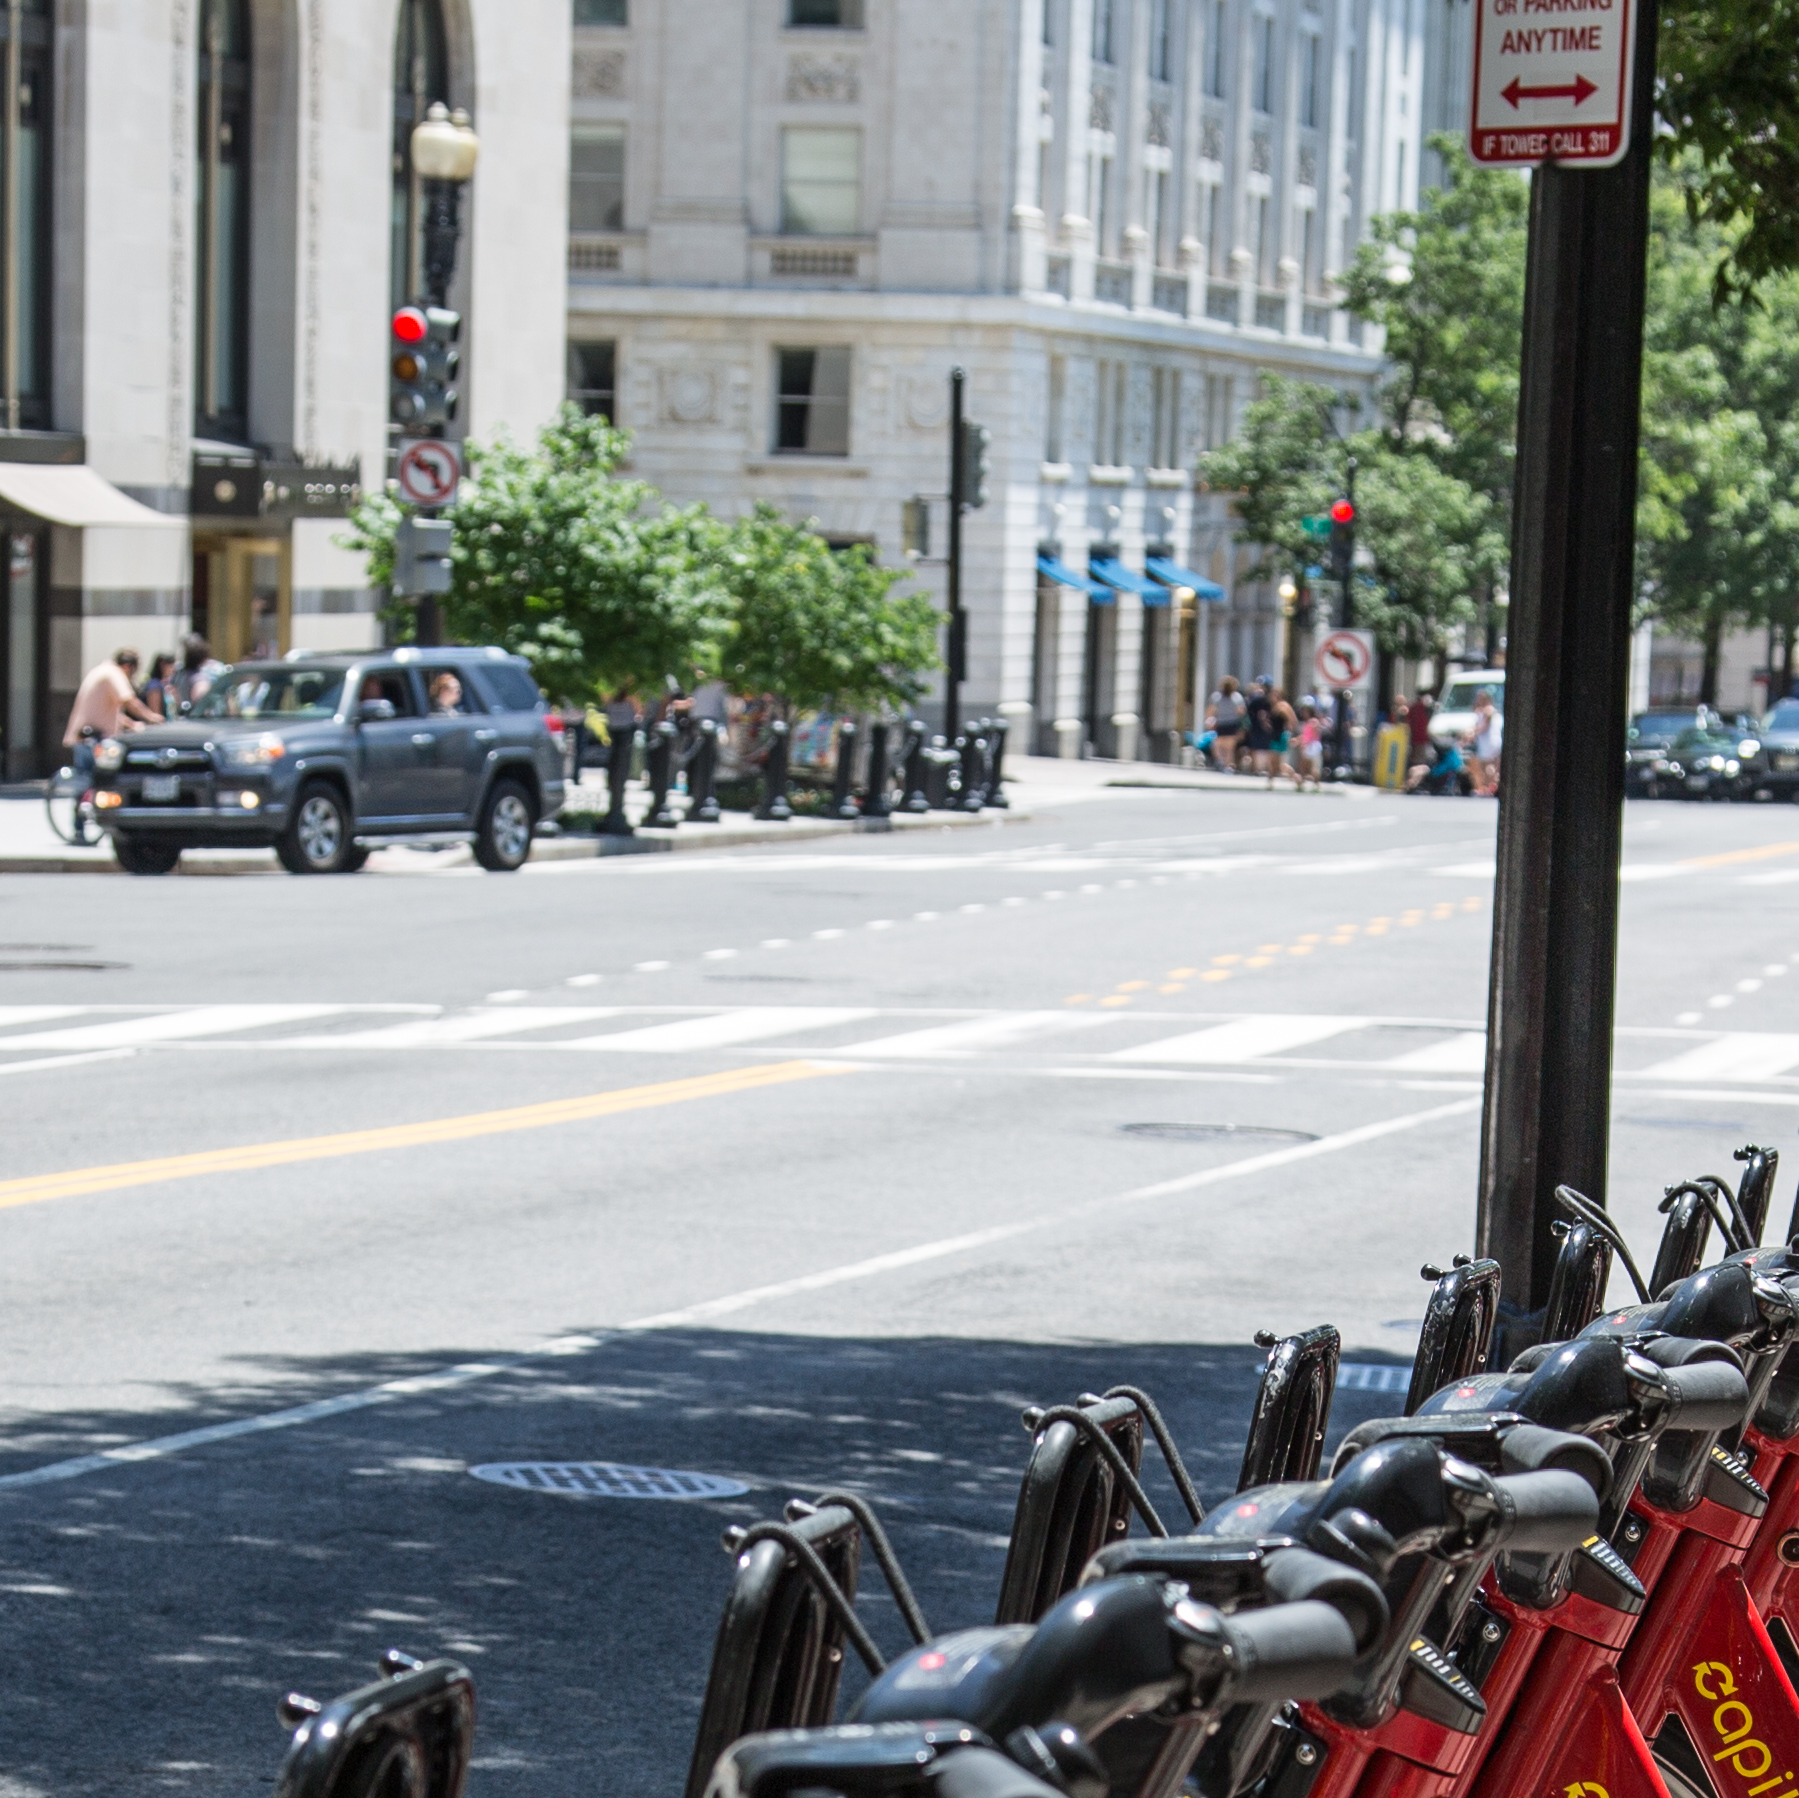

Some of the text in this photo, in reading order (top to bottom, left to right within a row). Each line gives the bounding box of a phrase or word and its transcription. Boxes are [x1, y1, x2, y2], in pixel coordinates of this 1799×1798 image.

[1501, 26, 1602, 54] ANYTIME
[1483, 131, 1610, 156] IF TOWED CALL 311
